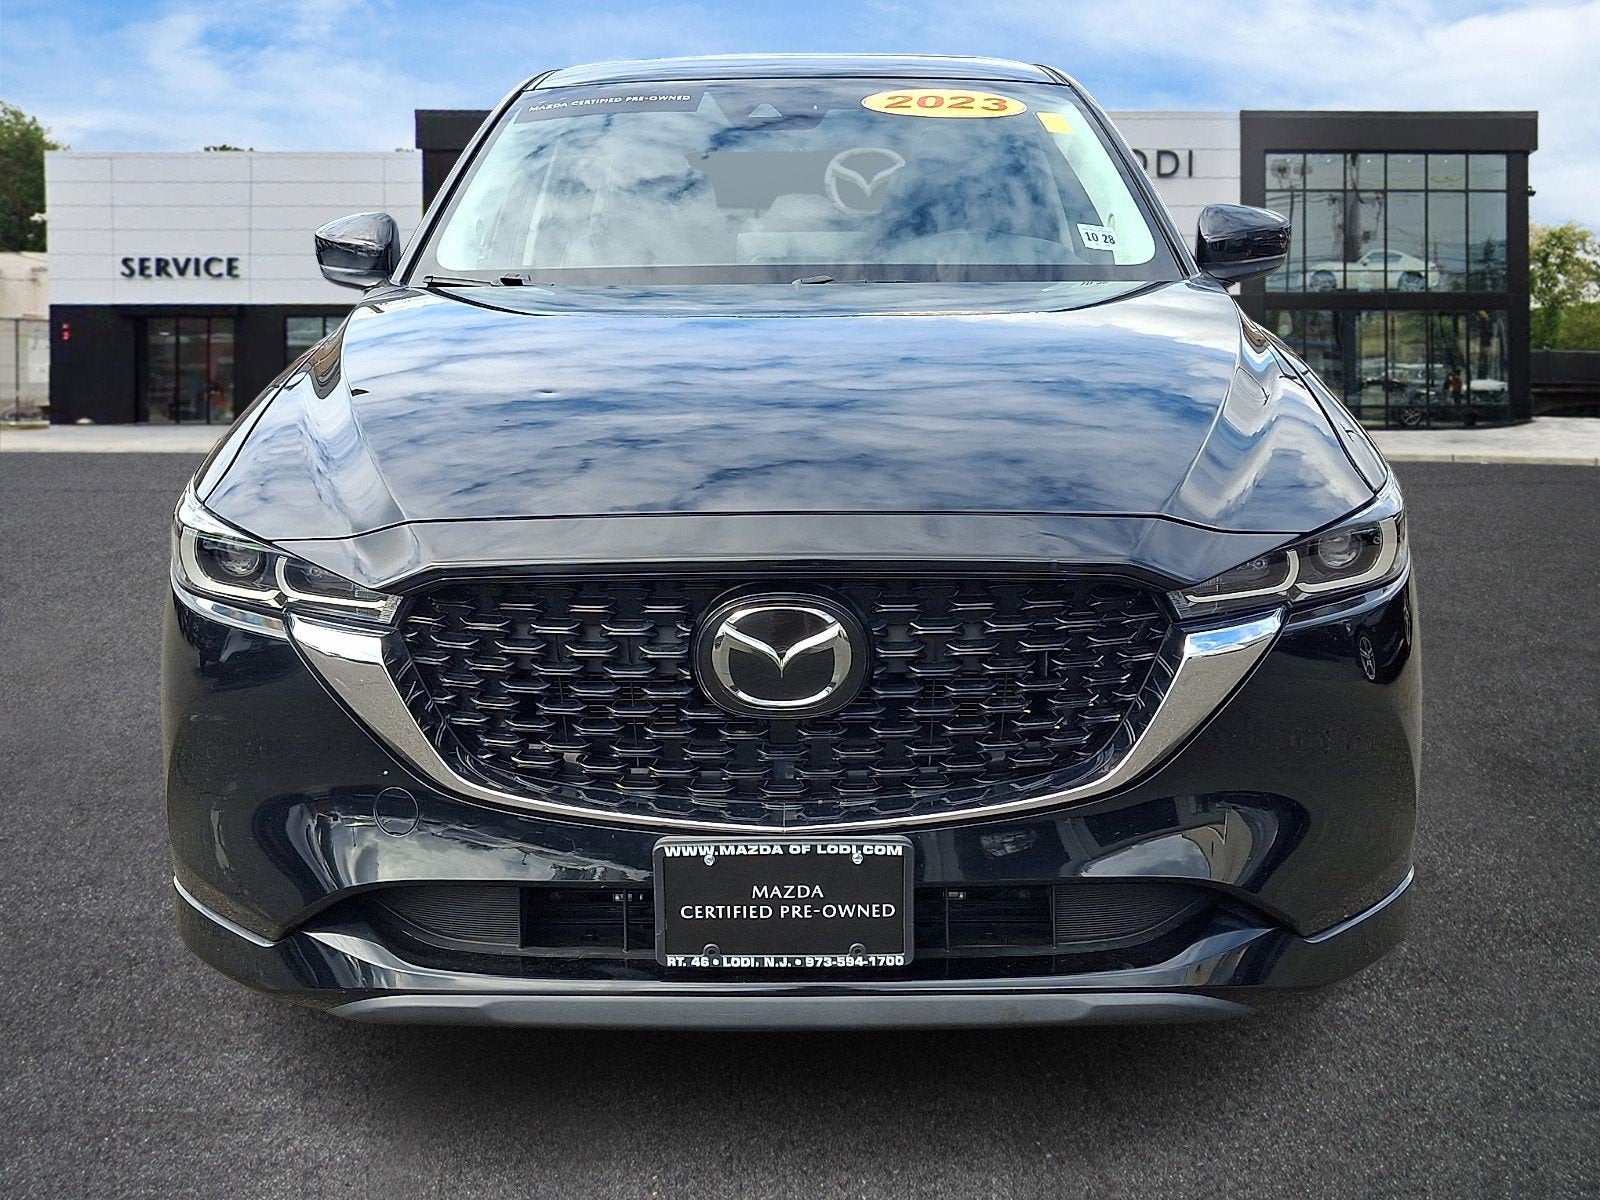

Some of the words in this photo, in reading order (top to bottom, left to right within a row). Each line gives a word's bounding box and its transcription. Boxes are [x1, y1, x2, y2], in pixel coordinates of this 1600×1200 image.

[528, 102, 568, 112] MAZDA
[571, 97, 622, 106] CERTIFIED
[884, 95, 1008, 112] 2023
[1085, 232, 1099, 242] 10
[1102, 234, 1116, 245] 28
[120, 257, 240, 279] SERVICE
[664, 844, 784, 857] WWW.MAZDA
[788, 844, 811, 855] OF
[816, 844, 903, 856] LODI.COM
[752, 885, 824, 899] MAZDA
[680, 905, 773, 919] CERTIFIED
[780, 904, 896, 918] PRE-OWNED
[667, 955, 687, 967] RT.
[691, 955, 710, 967] 46
[764, 956, 792, 967] N.J.
[805, 955, 905, 967] 973-594-1700
